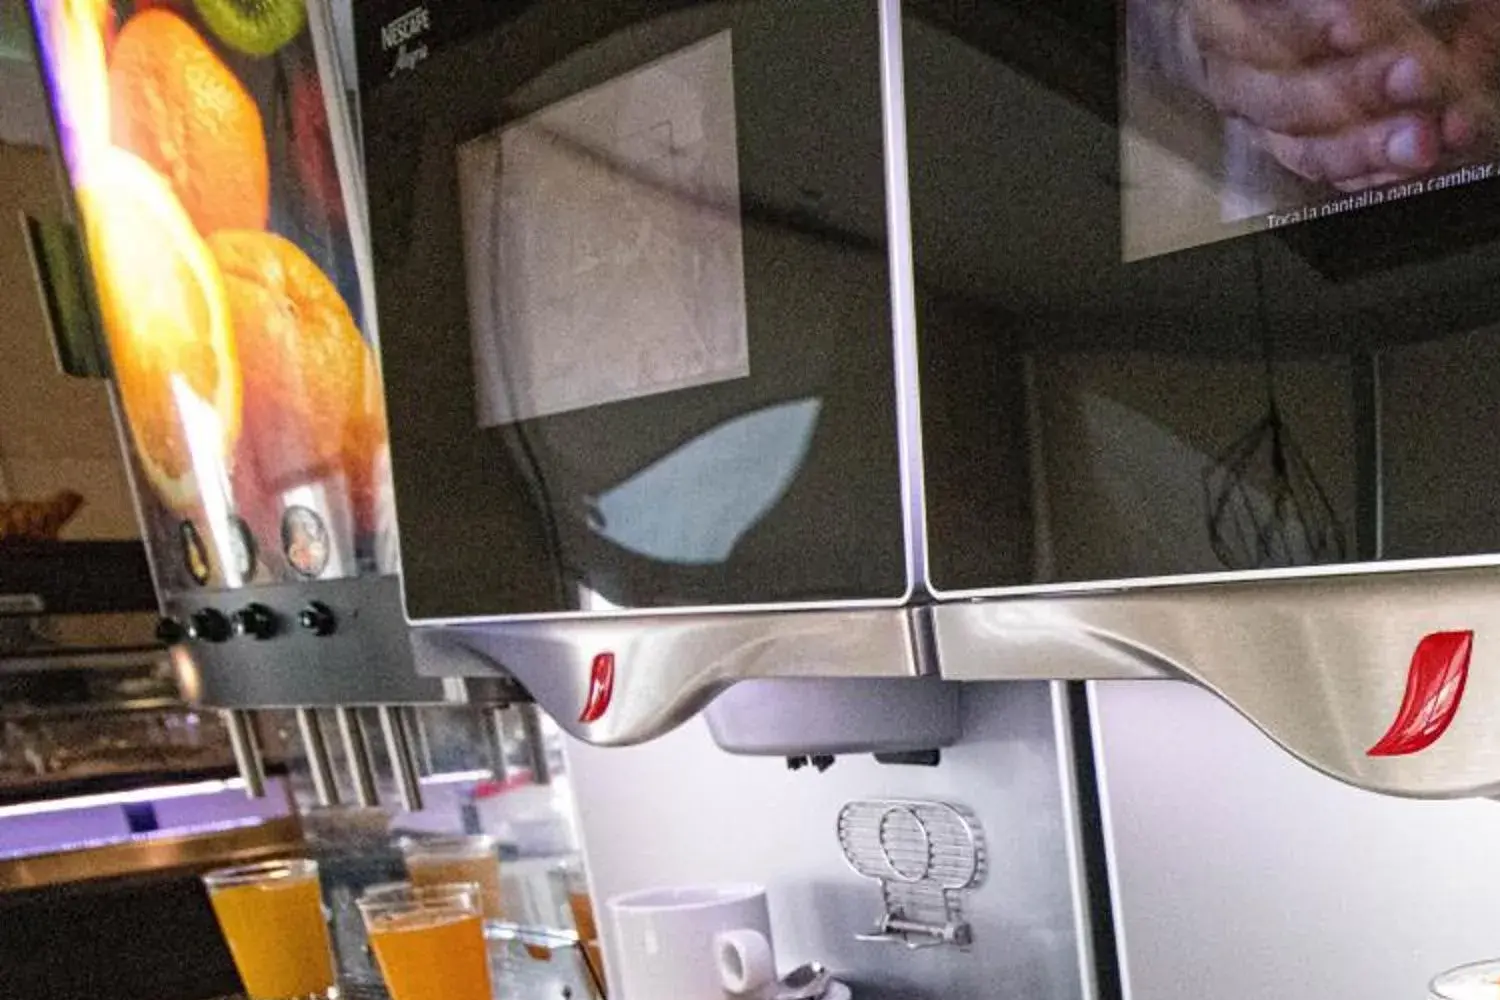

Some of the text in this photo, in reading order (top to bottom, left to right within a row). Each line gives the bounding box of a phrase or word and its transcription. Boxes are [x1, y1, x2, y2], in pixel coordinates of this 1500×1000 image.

[1303, 206, 1318, 221] la
[1321, 191, 1384, 217] pantalla
[1387, 181, 1423, 201] para
[1427, 163, 1493, 191] cambiar
